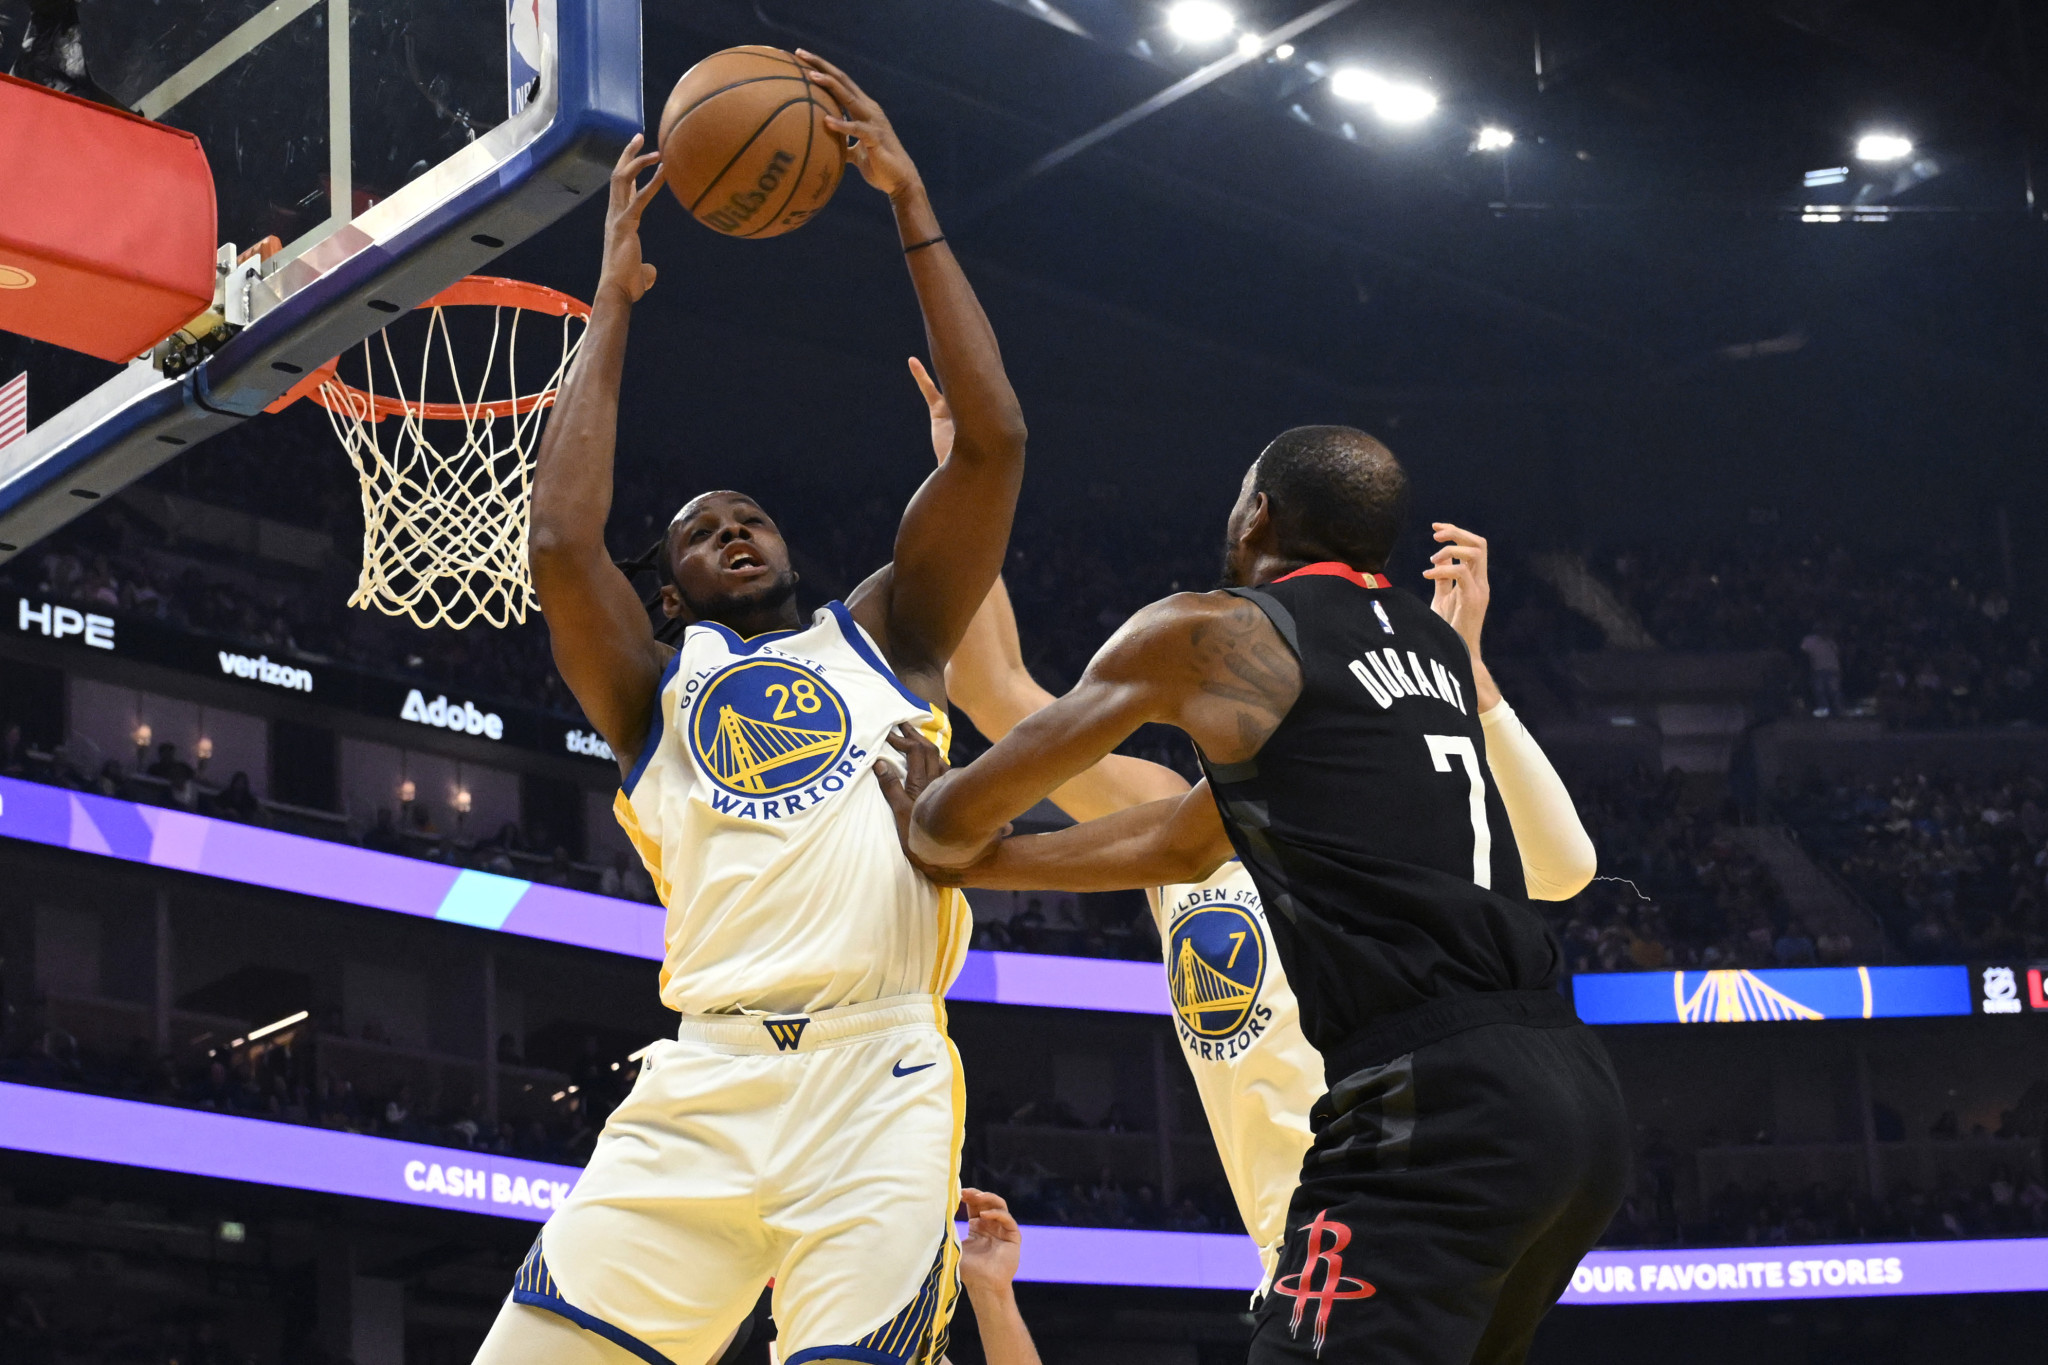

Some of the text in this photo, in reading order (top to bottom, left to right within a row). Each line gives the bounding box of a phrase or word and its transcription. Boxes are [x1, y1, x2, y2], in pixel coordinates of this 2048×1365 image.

[702, 151, 795, 231] Wilson
[18, 597, 115, 650] HPE
[218, 651, 313, 692] verizon
[762, 646, 827, 675] STATE
[1348, 647, 1467, 716] DURANT
[400, 688, 503, 740] Adobe
[765, 679, 821, 721] 28
[711, 744, 867, 820] WARRIORS
[1423, 734, 1491, 891] 7
[1227, 931, 1246, 969] 7
[1177, 1004, 1272, 1061] WARRIORS
[404, 1160, 570, 1211] CASH BACK
[1565, 1257, 1903, 1293] OUR FAVORITE STORES
